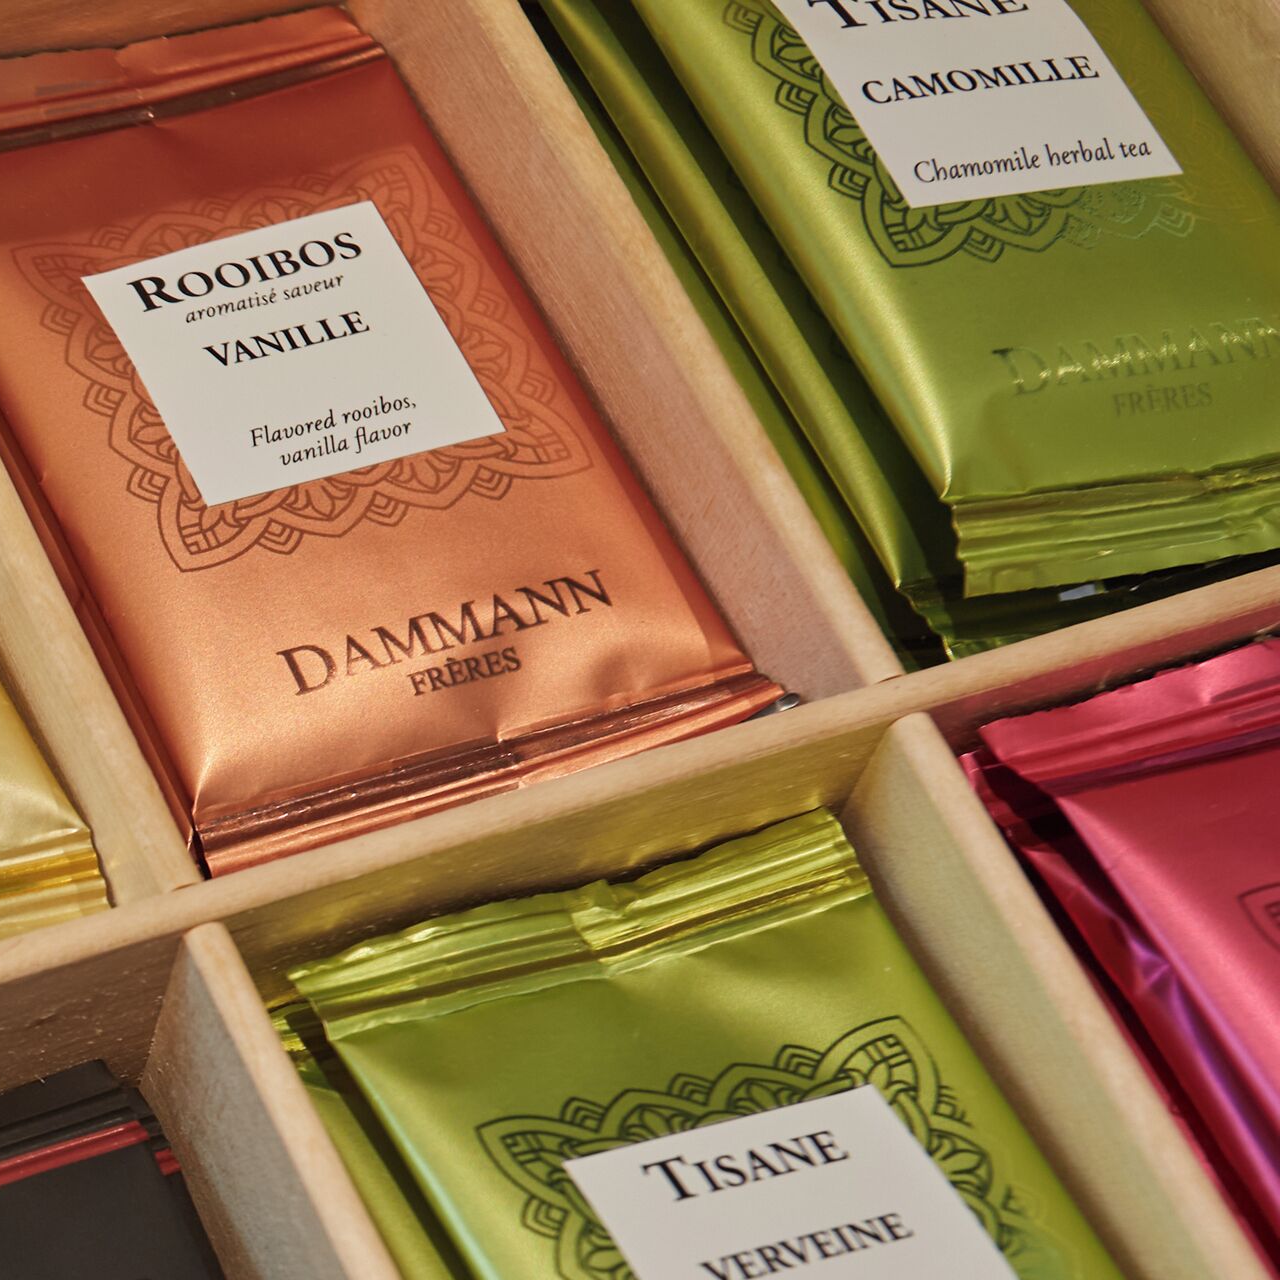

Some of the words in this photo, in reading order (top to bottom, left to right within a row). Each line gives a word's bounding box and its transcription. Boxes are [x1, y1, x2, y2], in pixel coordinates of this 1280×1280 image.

[862, 55, 1099, 103] CAMOMILLE
[914, 152, 1040, 183] Chamomile
[1049, 138, 1115, 167] herbal
[1119, 139, 1152, 159] tea
[127, 232, 363, 312] ROOIBOS
[185, 289, 277, 323] aromatisé
[283, 274, 344, 301] saveur
[202, 311, 370, 367] VANILLE
[250, 410, 337, 447] Flavored
[343, 395, 417, 425] rooibos,
[280, 435, 350, 466] vanilla
[355, 420, 412, 454] flavor
[276, 569, 613, 696] DAMMANN
[407, 646, 521, 696] FRÈRES
[641, 1130, 849, 1202] TISANE
